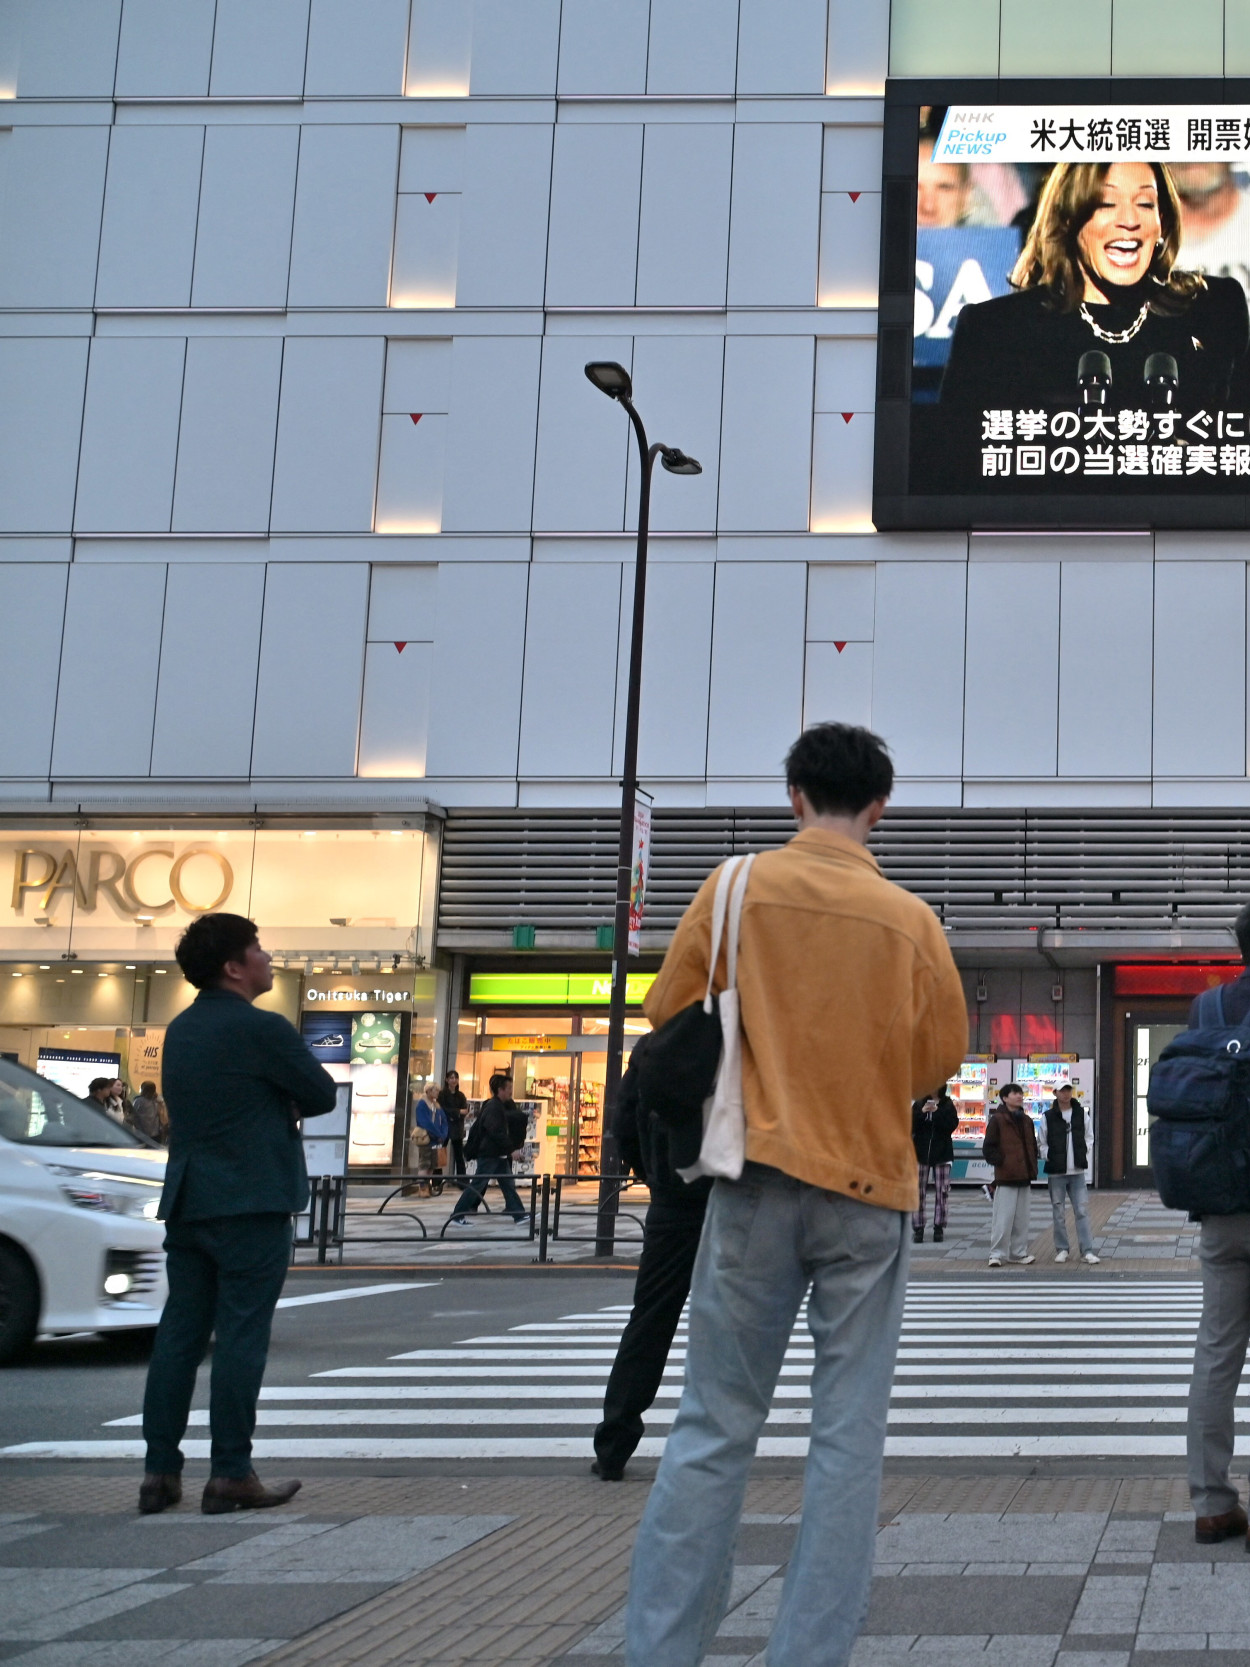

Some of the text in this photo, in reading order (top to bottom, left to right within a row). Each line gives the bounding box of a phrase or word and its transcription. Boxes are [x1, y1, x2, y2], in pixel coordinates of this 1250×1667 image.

[954, 112, 995, 123] NHK
[947, 129, 1007, 145] Pickup
[1029, 118, 1171, 152] 米大統領選
[943, 143, 993, 155] NEWS
[11, 848, 235, 912] PARCO
[306, 988, 409, 1004] Onitsuka Tiger
